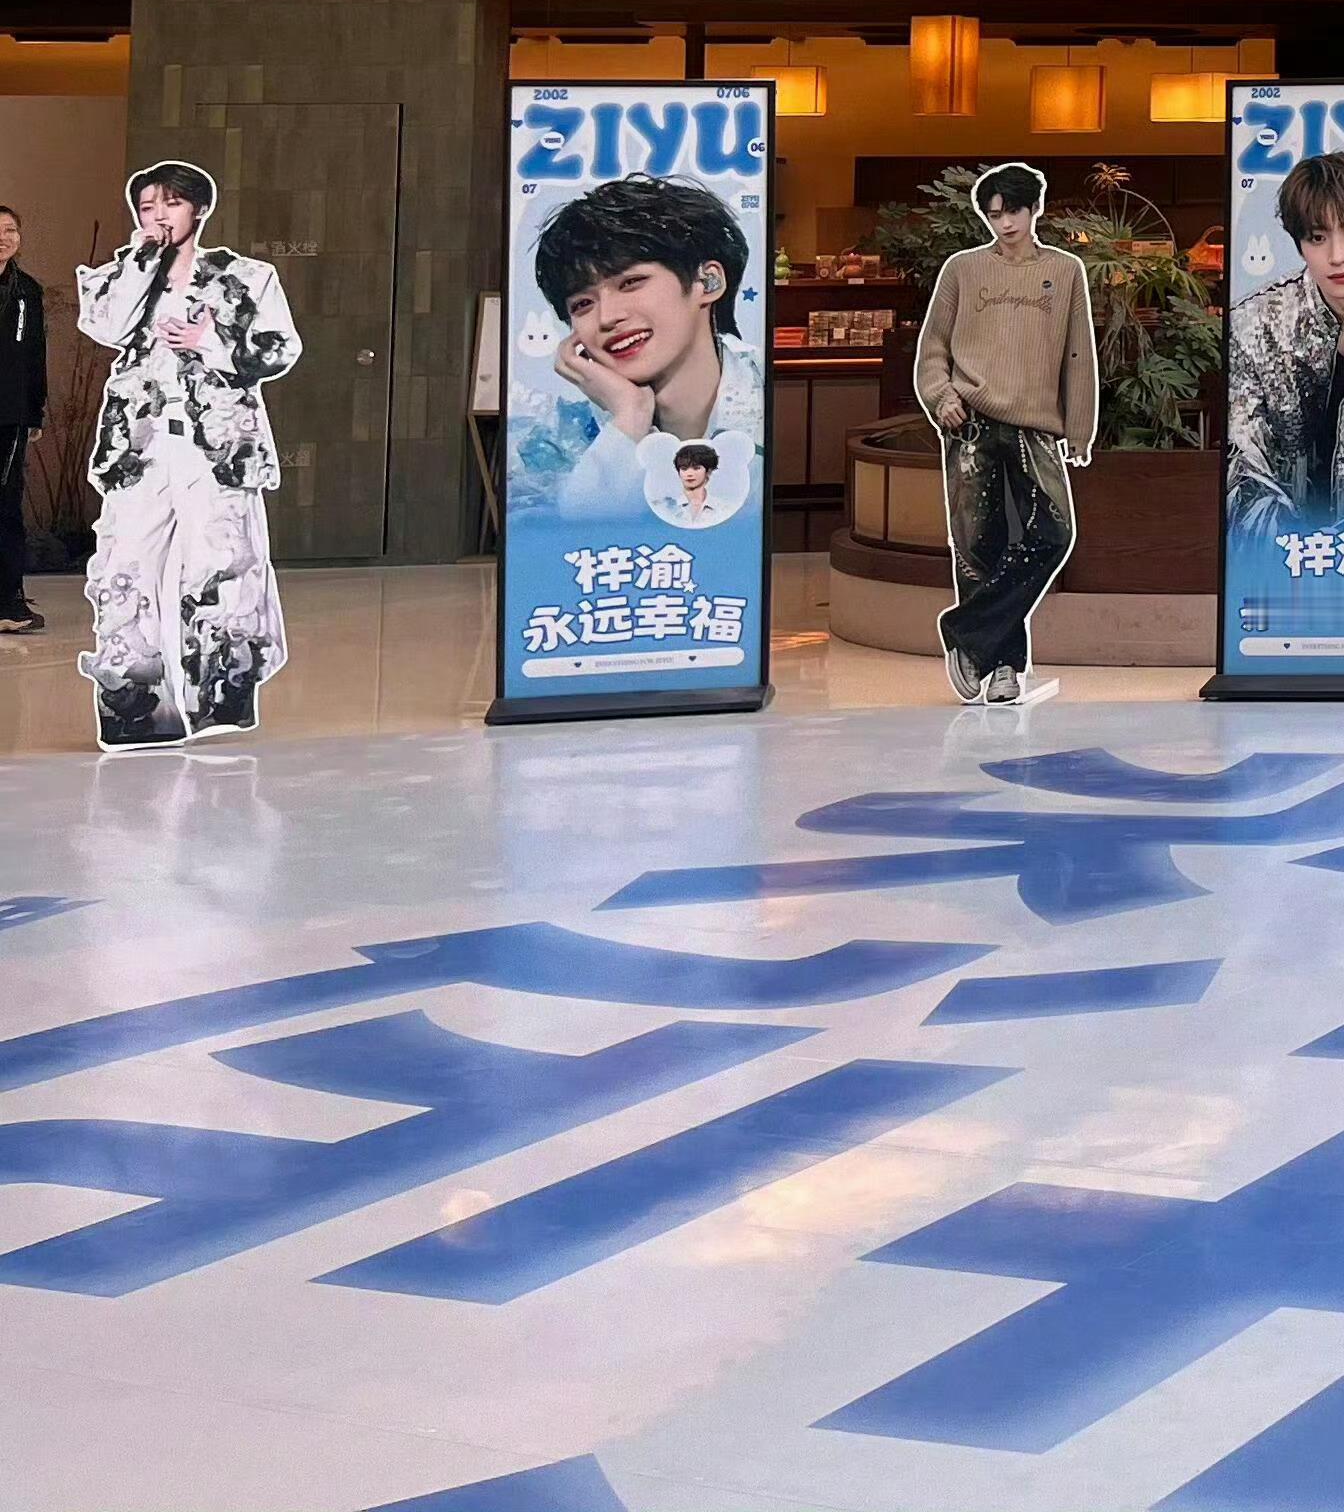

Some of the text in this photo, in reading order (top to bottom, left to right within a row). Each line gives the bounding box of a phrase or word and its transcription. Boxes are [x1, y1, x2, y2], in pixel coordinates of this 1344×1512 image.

[533, 86, 750, 100] 2002 0706
[1251, 88, 1281, 99] 2002
[517, 101, 763, 180] ZIYU
[750, 142, 766, 153] 06
[521, 183, 538, 194] 07
[1241, 178, 1255, 189] 07
[574, 543, 694, 594] 梓渝
[522, 594, 748, 652] 永远幸福
